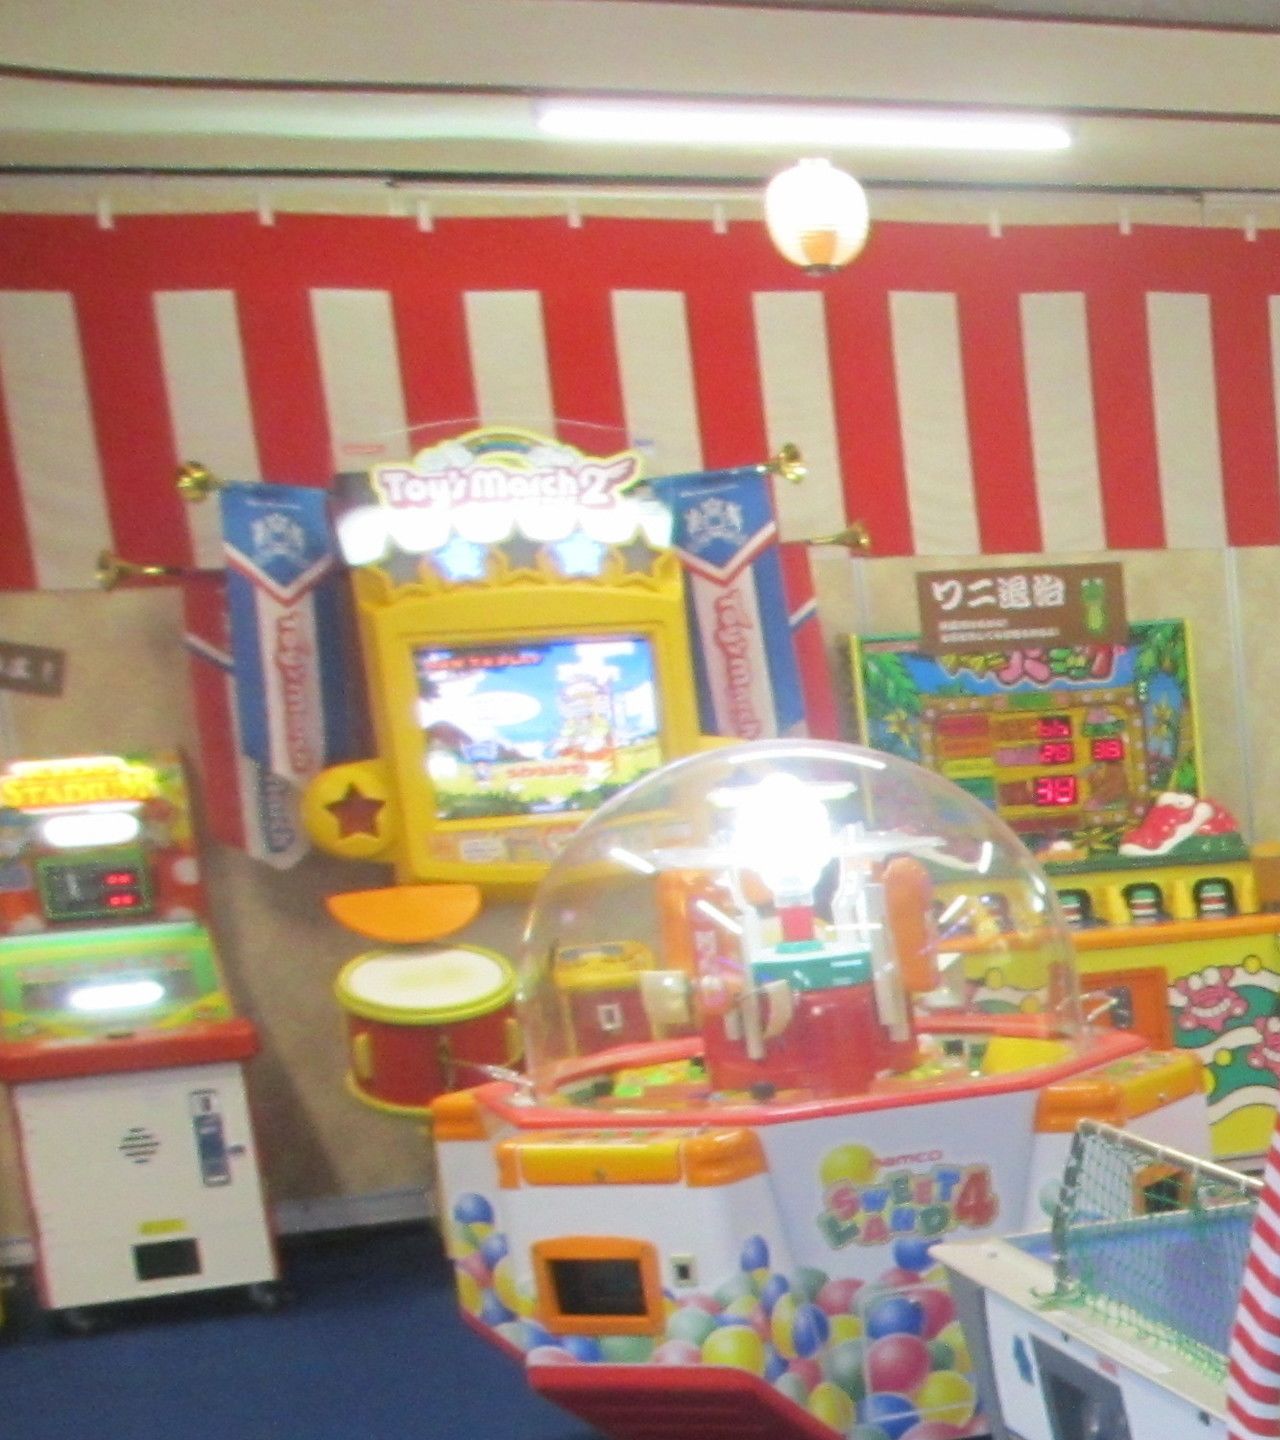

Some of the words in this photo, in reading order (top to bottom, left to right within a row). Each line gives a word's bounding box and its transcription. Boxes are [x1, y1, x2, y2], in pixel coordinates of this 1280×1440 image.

[931, 575, 1066, 610] ワニ退治
[829, 1168, 962, 1224] SWEET
[954, 1166, 1000, 1228] 4
[819, 1201, 952, 1250] LAND
